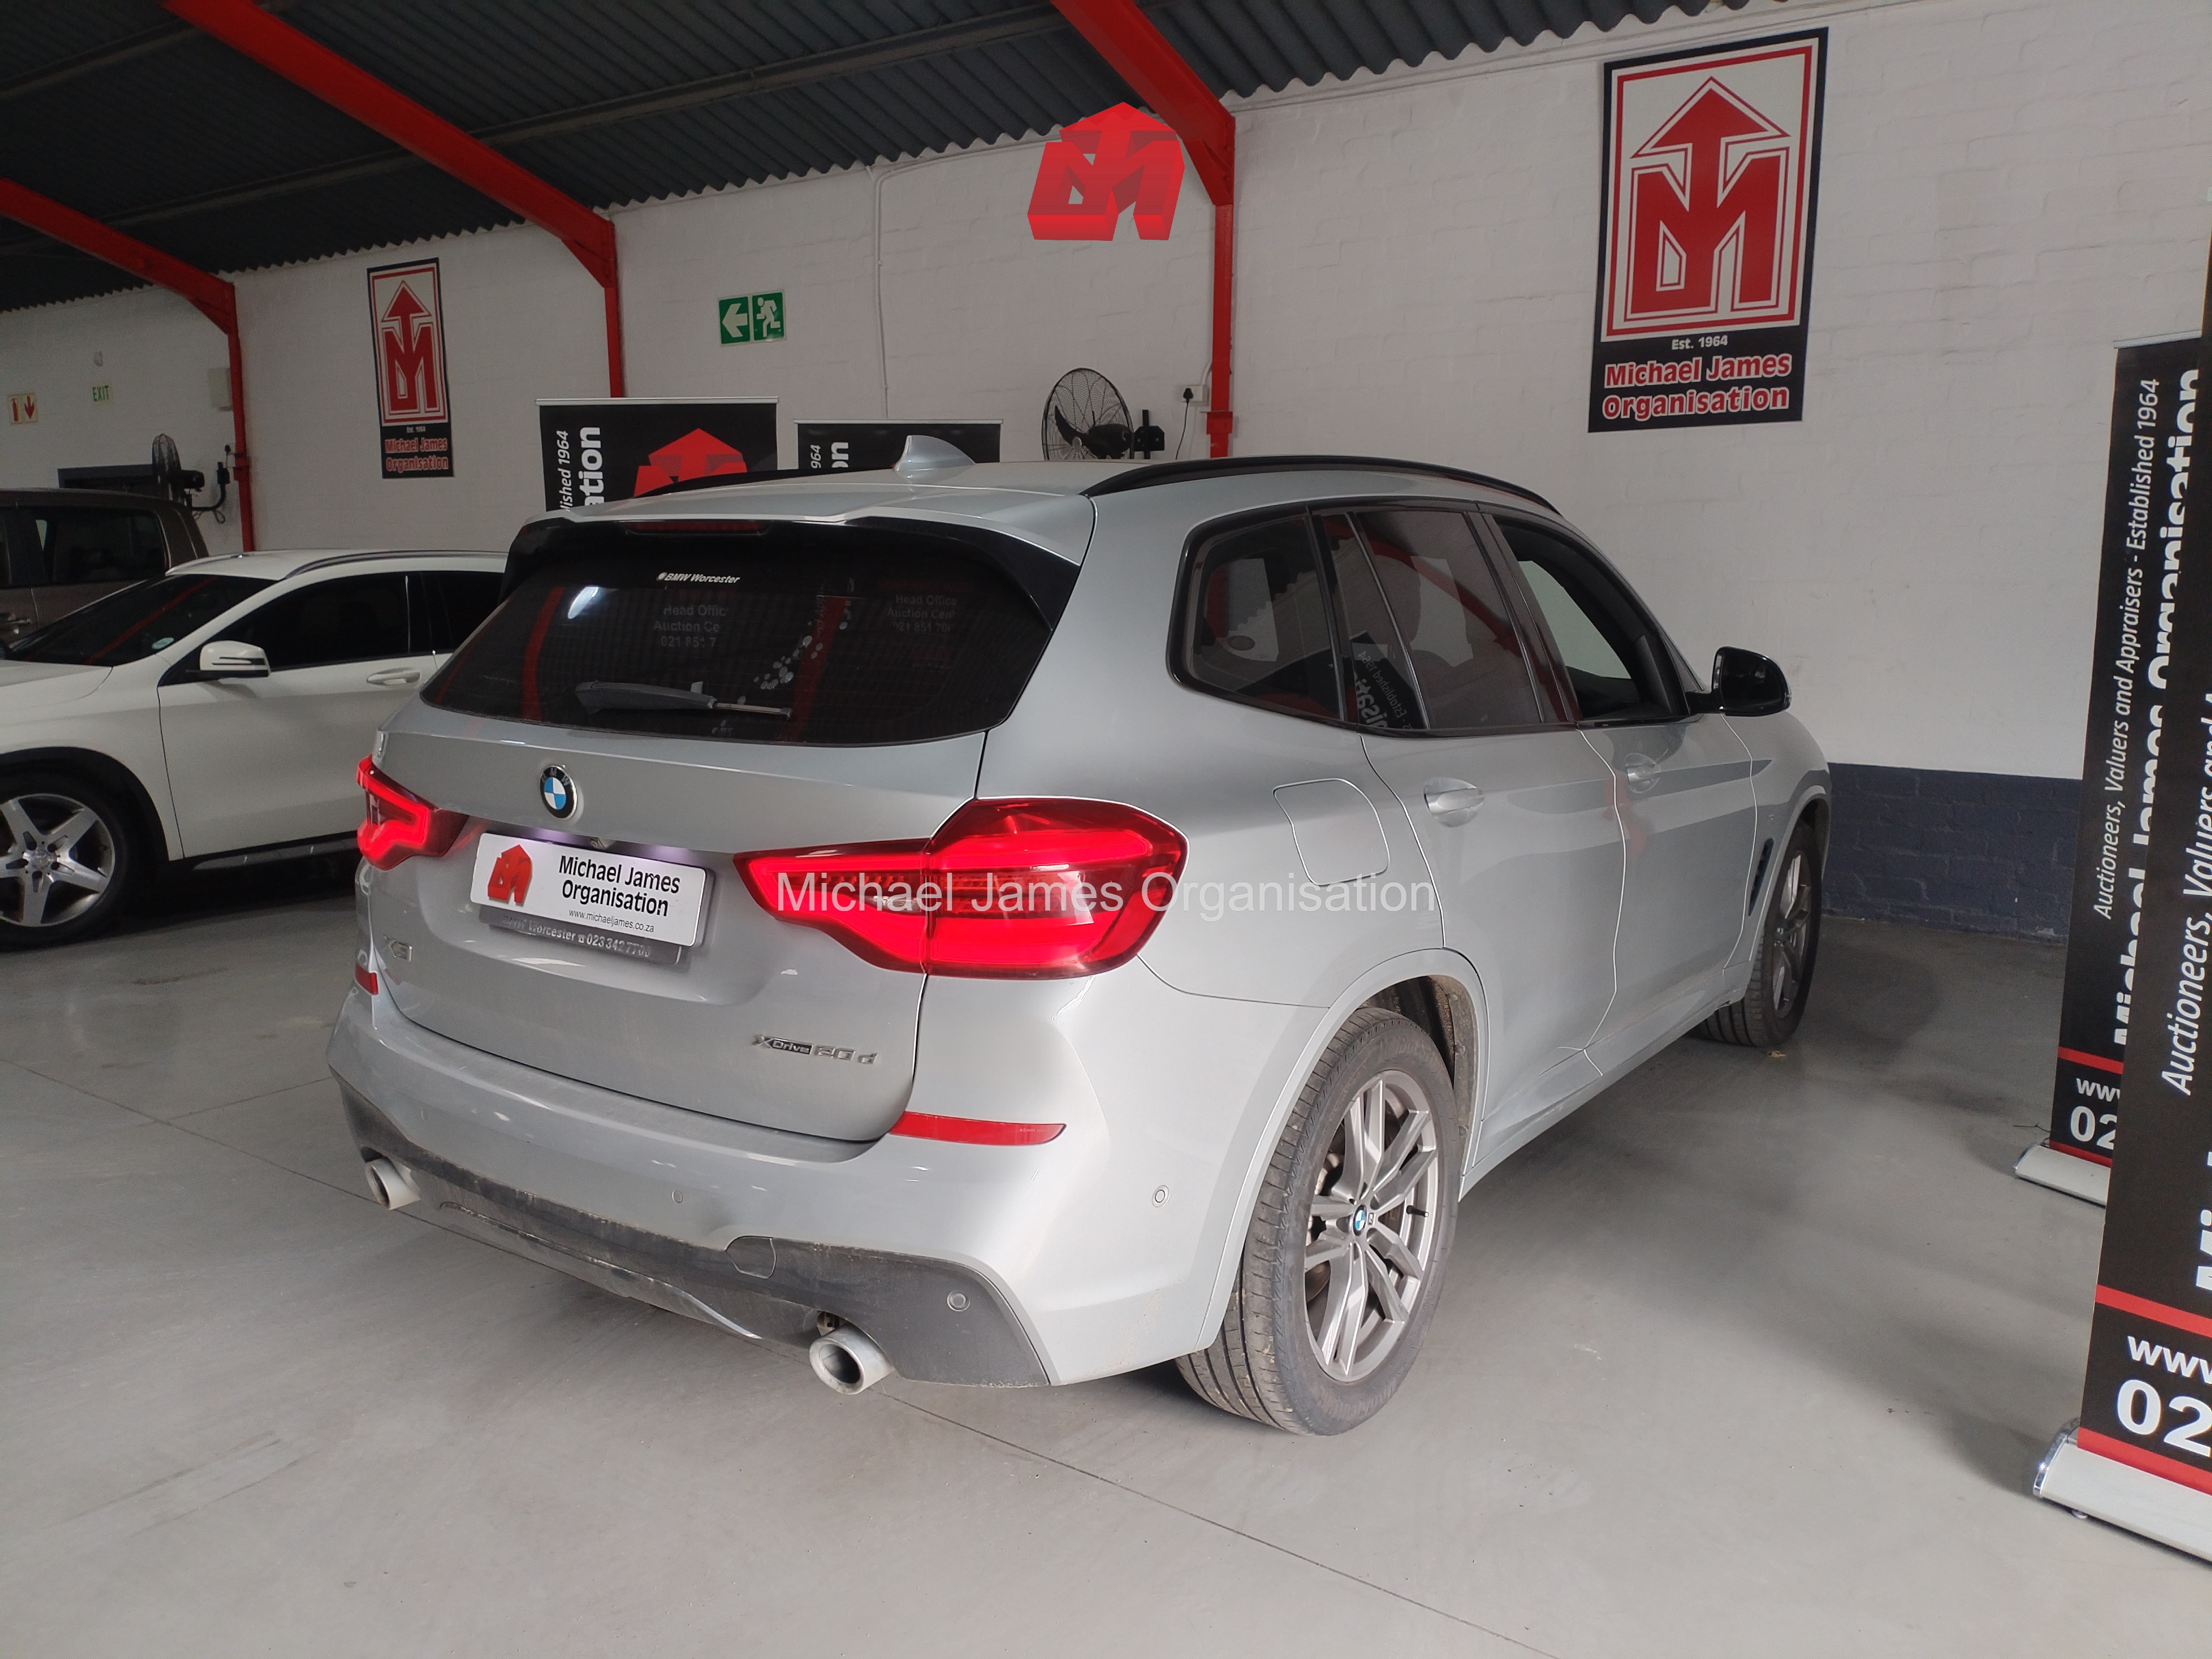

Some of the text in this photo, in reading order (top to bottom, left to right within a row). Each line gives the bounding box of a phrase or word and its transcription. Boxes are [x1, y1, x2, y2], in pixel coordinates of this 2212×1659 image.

[1671, 335, 1728, 350] Est. 1964
[1604, 353, 1792, 388] Michael James
[92, 385, 109, 401] EXIT
[1602, 386, 1789, 421] Organisation
[2137, 379, 2160, 429] 1964
[385, 437, 448, 453] Michael James
[557, 430, 570, 464] 1964
[386, 455, 449, 473] Organisation
[2126, 435, 2155, 550] Established
[664, 573, 740, 583] BMW Worcester
[887, 608, 928, 619] Auction
[895, 595, 922, 605] Head
[654, 621, 700, 632] Auction
[2115, 566, 2143, 675] Appraisers
[2113, 676, 2133, 716] and
[2105, 720, 2129, 791] Valuers
[559, 855, 680, 894] Michael James
[2093, 800, 2126, 920] Auctioneers,
[562, 880, 669, 917] Organisation
[528, 919, 576, 941] Worcester
[569, 909, 655, 933] www.michaeljames.co.za
[2076, 1078, 2121, 1102] ww
[2071, 1106, 2117, 1150] 02
[2117, 1379, 2212, 1457] 02
